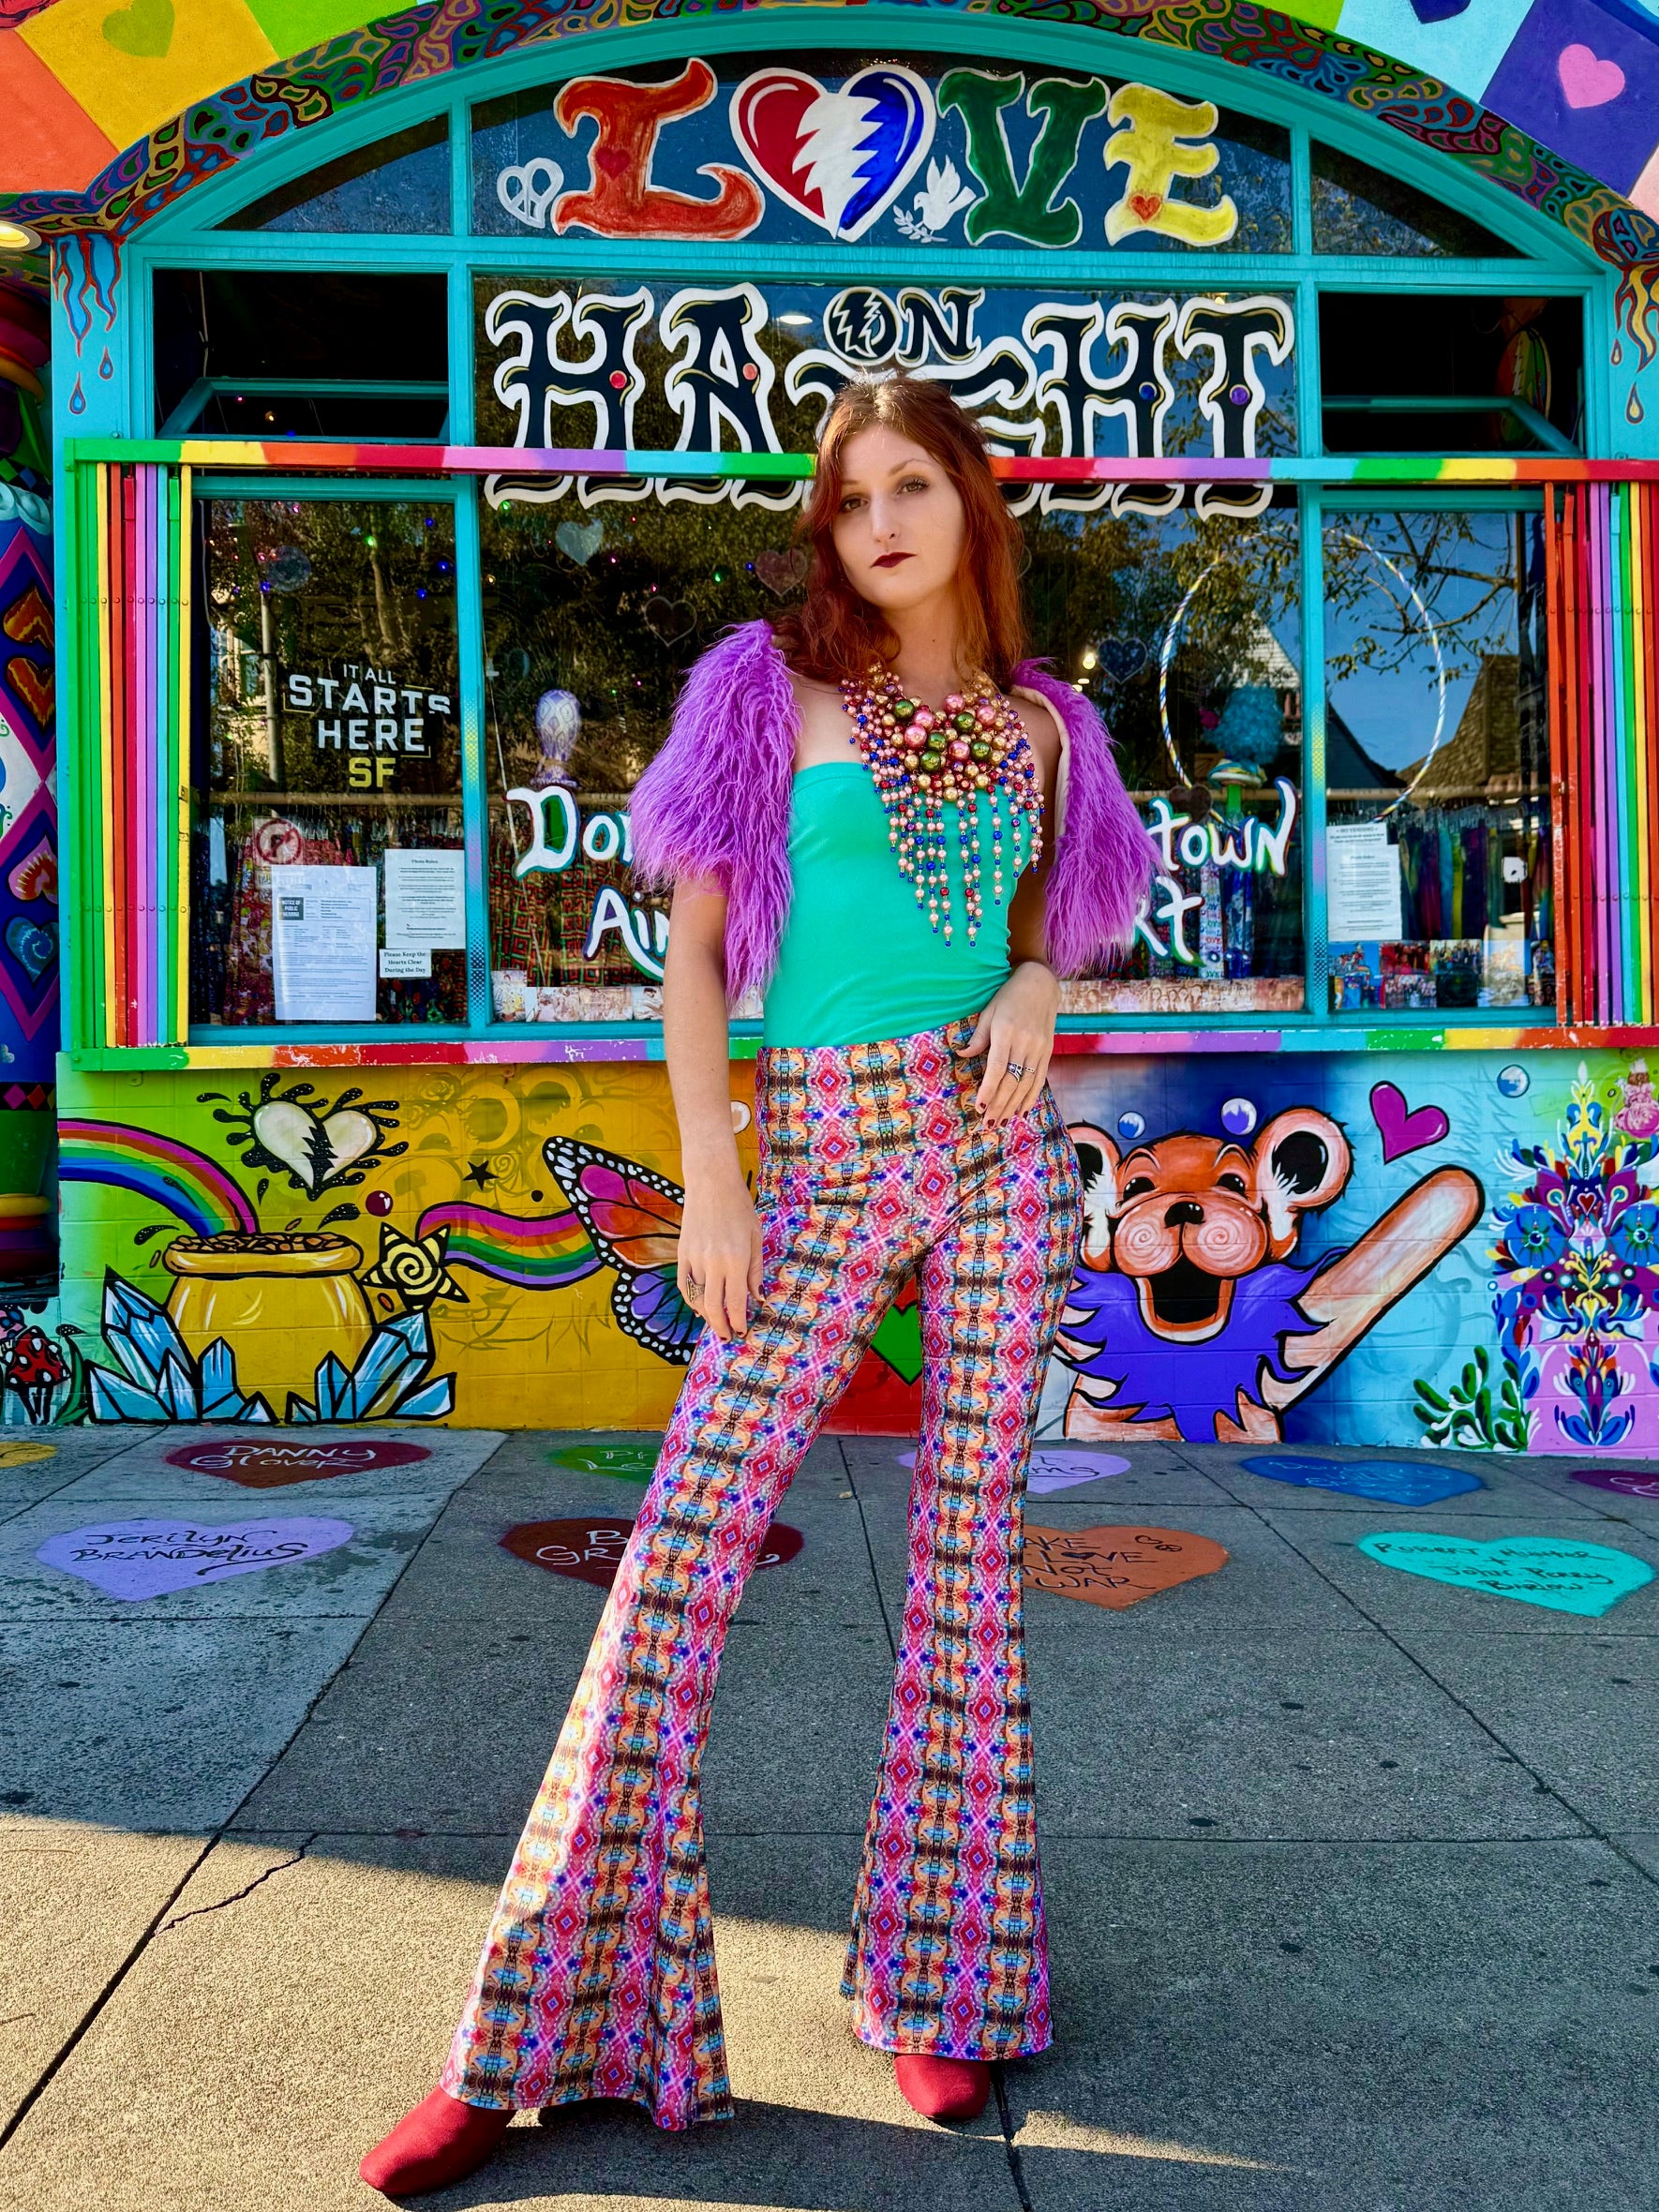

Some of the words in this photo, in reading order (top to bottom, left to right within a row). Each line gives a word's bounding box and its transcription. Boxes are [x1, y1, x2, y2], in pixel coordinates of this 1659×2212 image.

[485, 282, 1295, 519] HAGHT
[343, 664, 359, 679] IT
[365, 666, 396, 685] ALL
[289, 674, 452, 715] STARTS
[318, 718, 426, 752] HERE
[349, 756, 396, 788] SF
[1024, 1535, 1101, 1551] AKE
